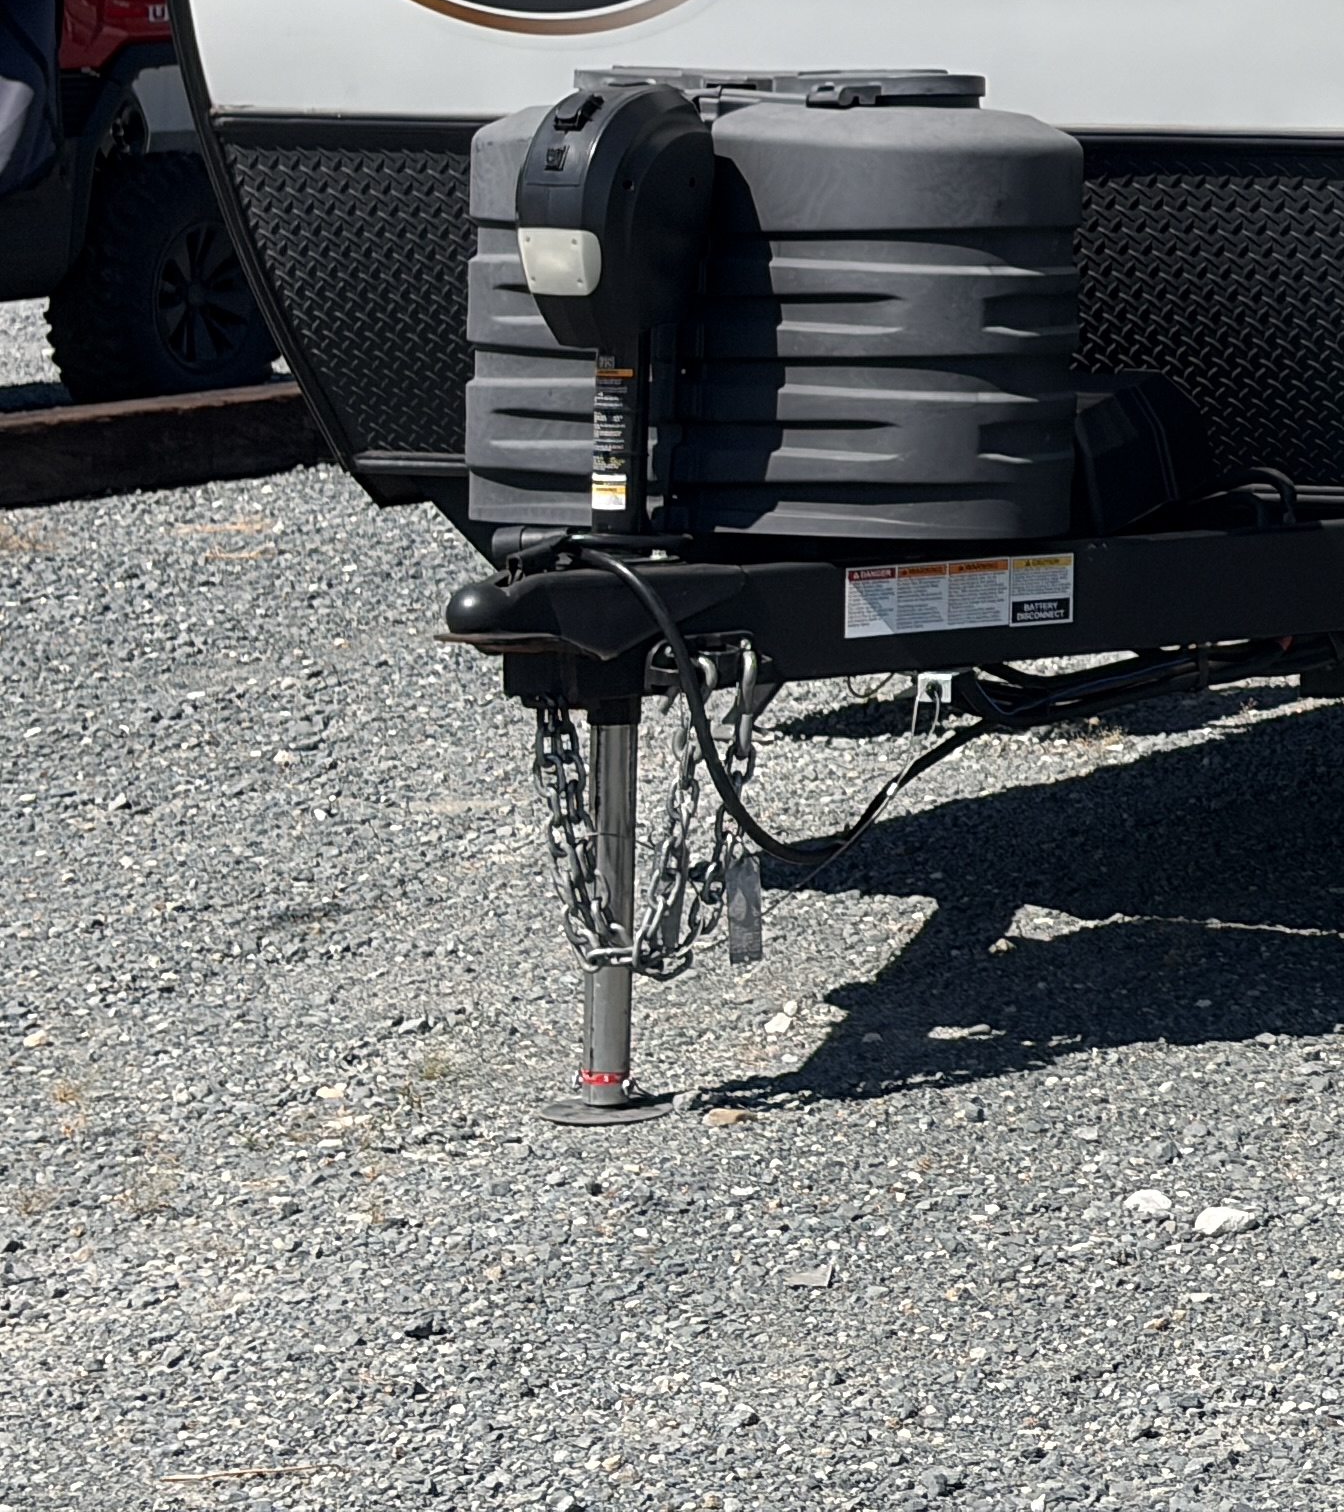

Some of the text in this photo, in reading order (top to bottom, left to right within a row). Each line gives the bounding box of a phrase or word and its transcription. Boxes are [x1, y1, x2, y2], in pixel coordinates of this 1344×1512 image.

[860, 569, 892, 580] DANGER
[1023, 601, 1059, 613] BATTERY
[1016, 609, 1065, 621] DISCONNECT
